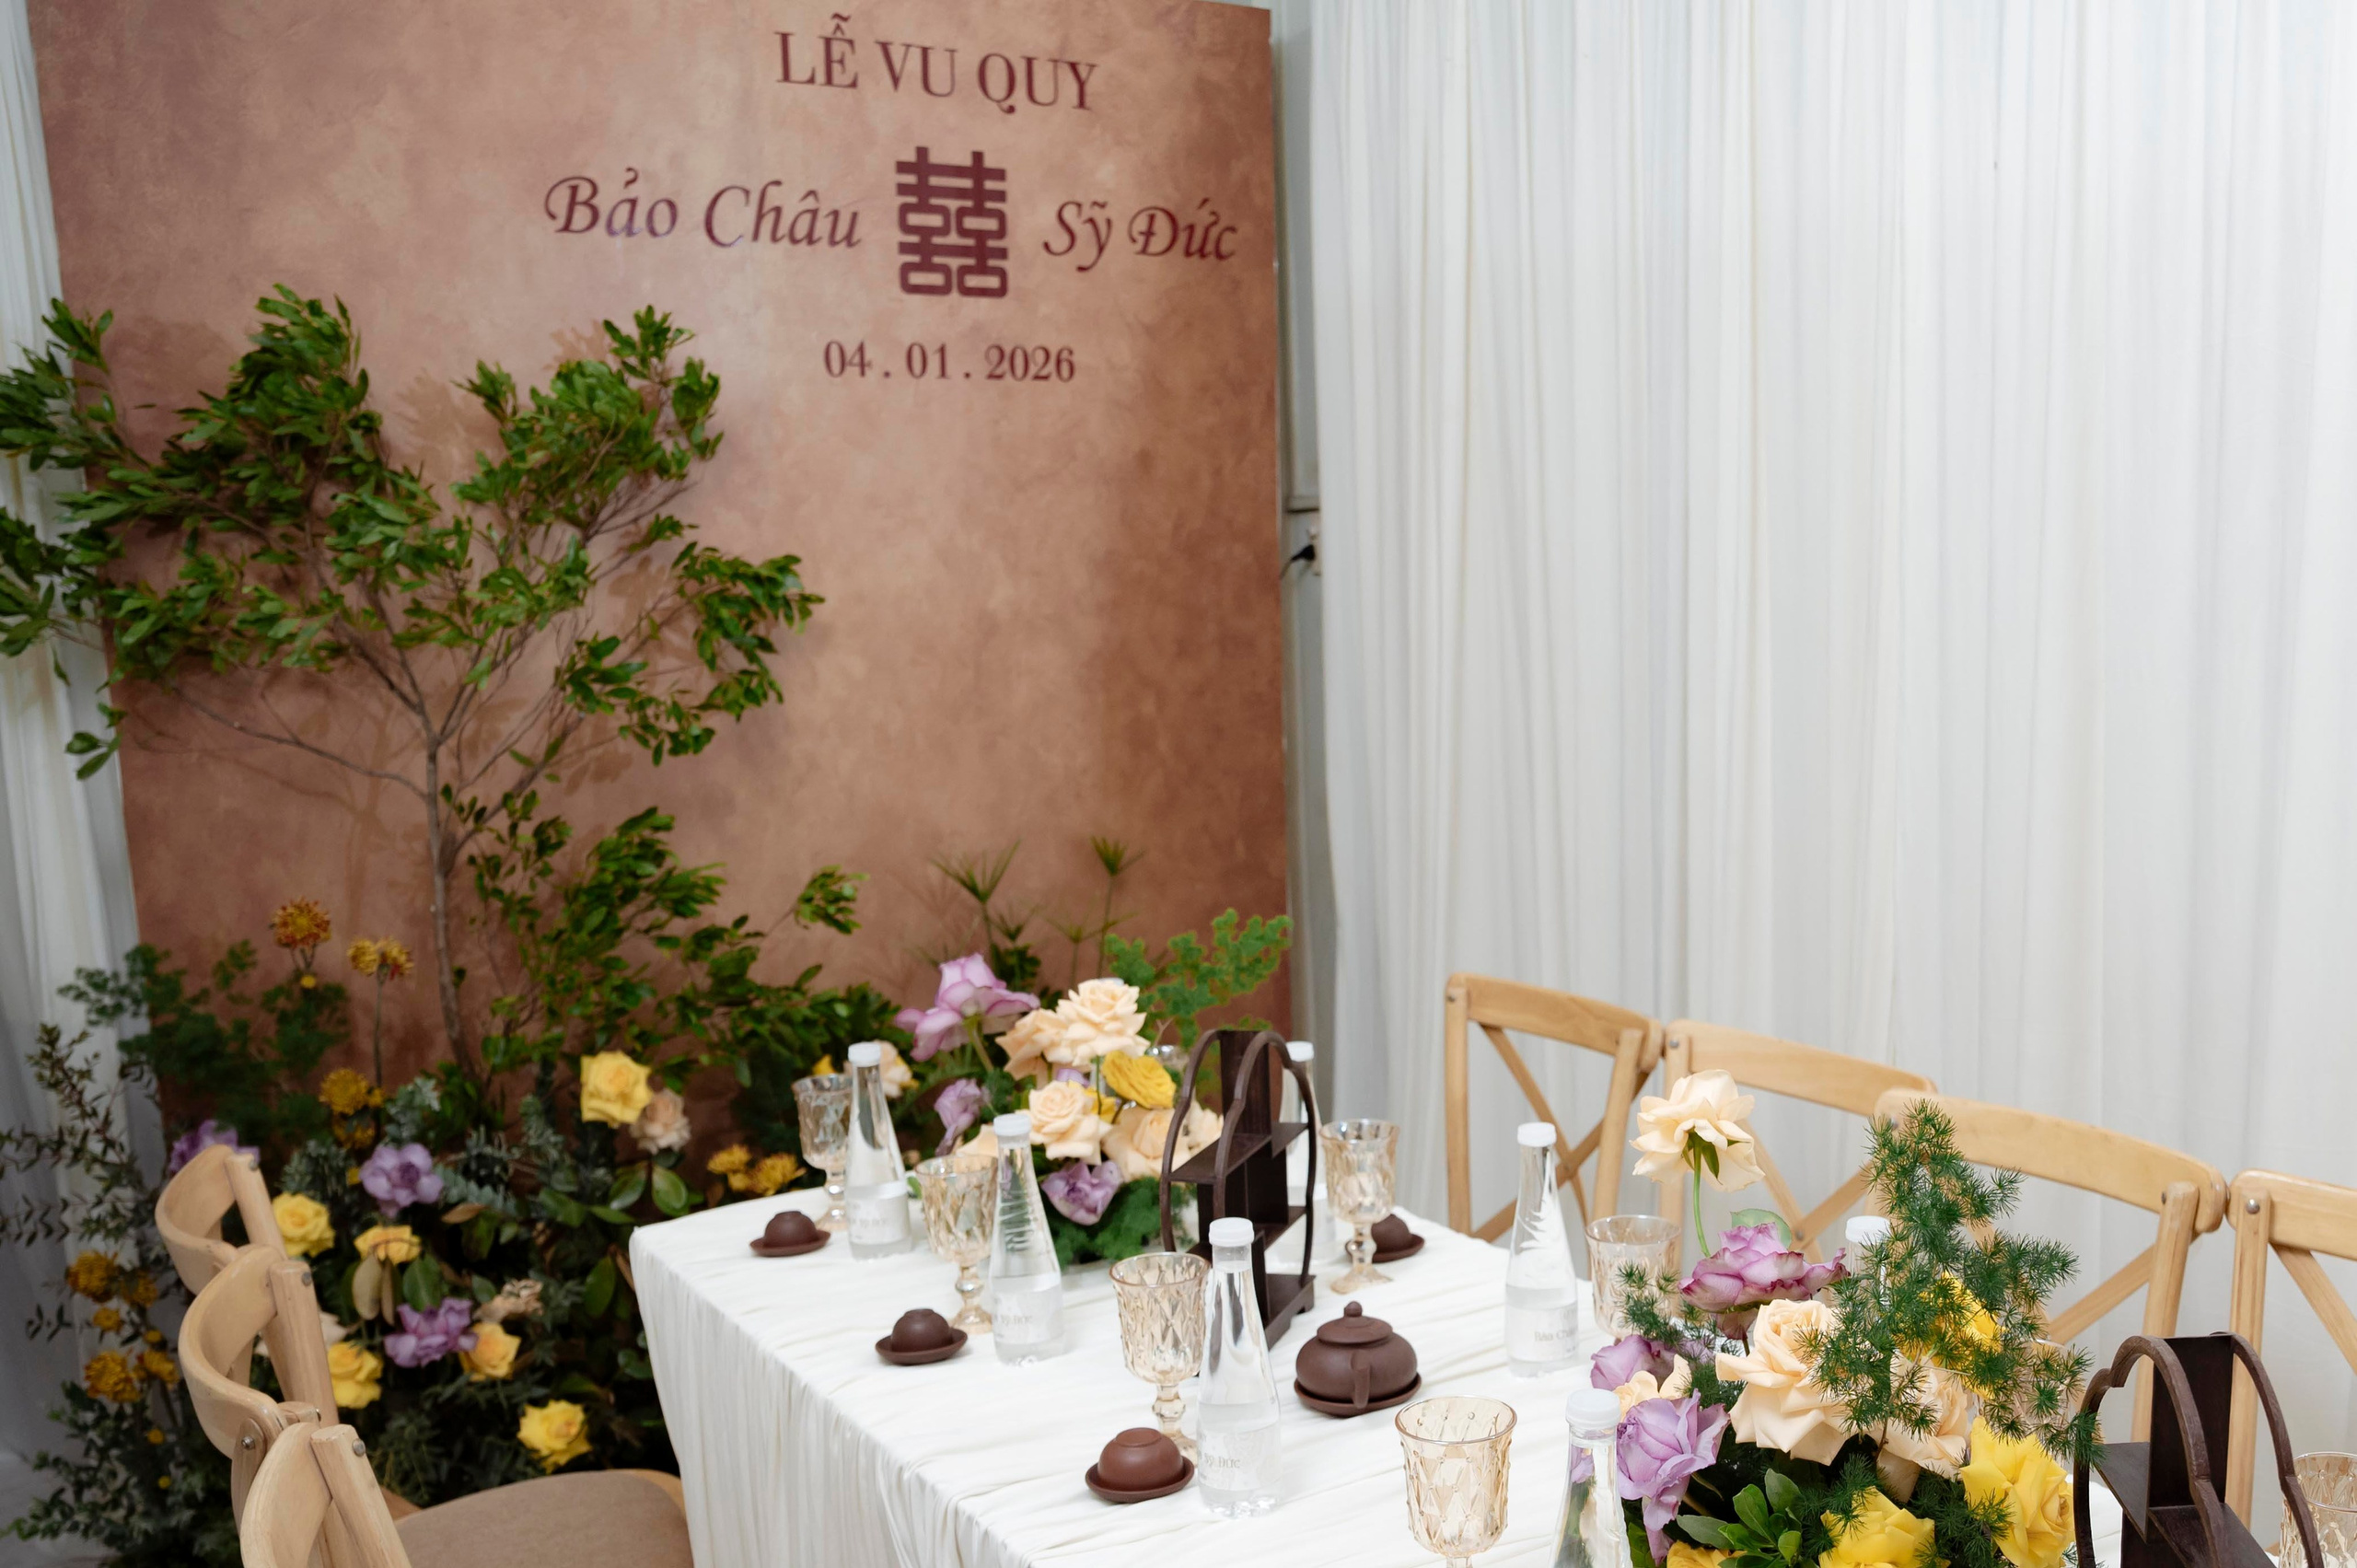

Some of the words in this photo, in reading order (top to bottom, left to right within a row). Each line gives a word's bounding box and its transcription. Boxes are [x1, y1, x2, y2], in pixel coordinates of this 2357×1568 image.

[774, 12, 859, 89] LỄ
[874, 40, 958, 98] VU
[977, 52, 1099, 114] QUY
[544, 167, 679, 238] Bảo
[704, 180, 863, 249] Châu
[1043, 200, 1113, 273] Sỹ
[1128, 197, 1238, 262] Đức
